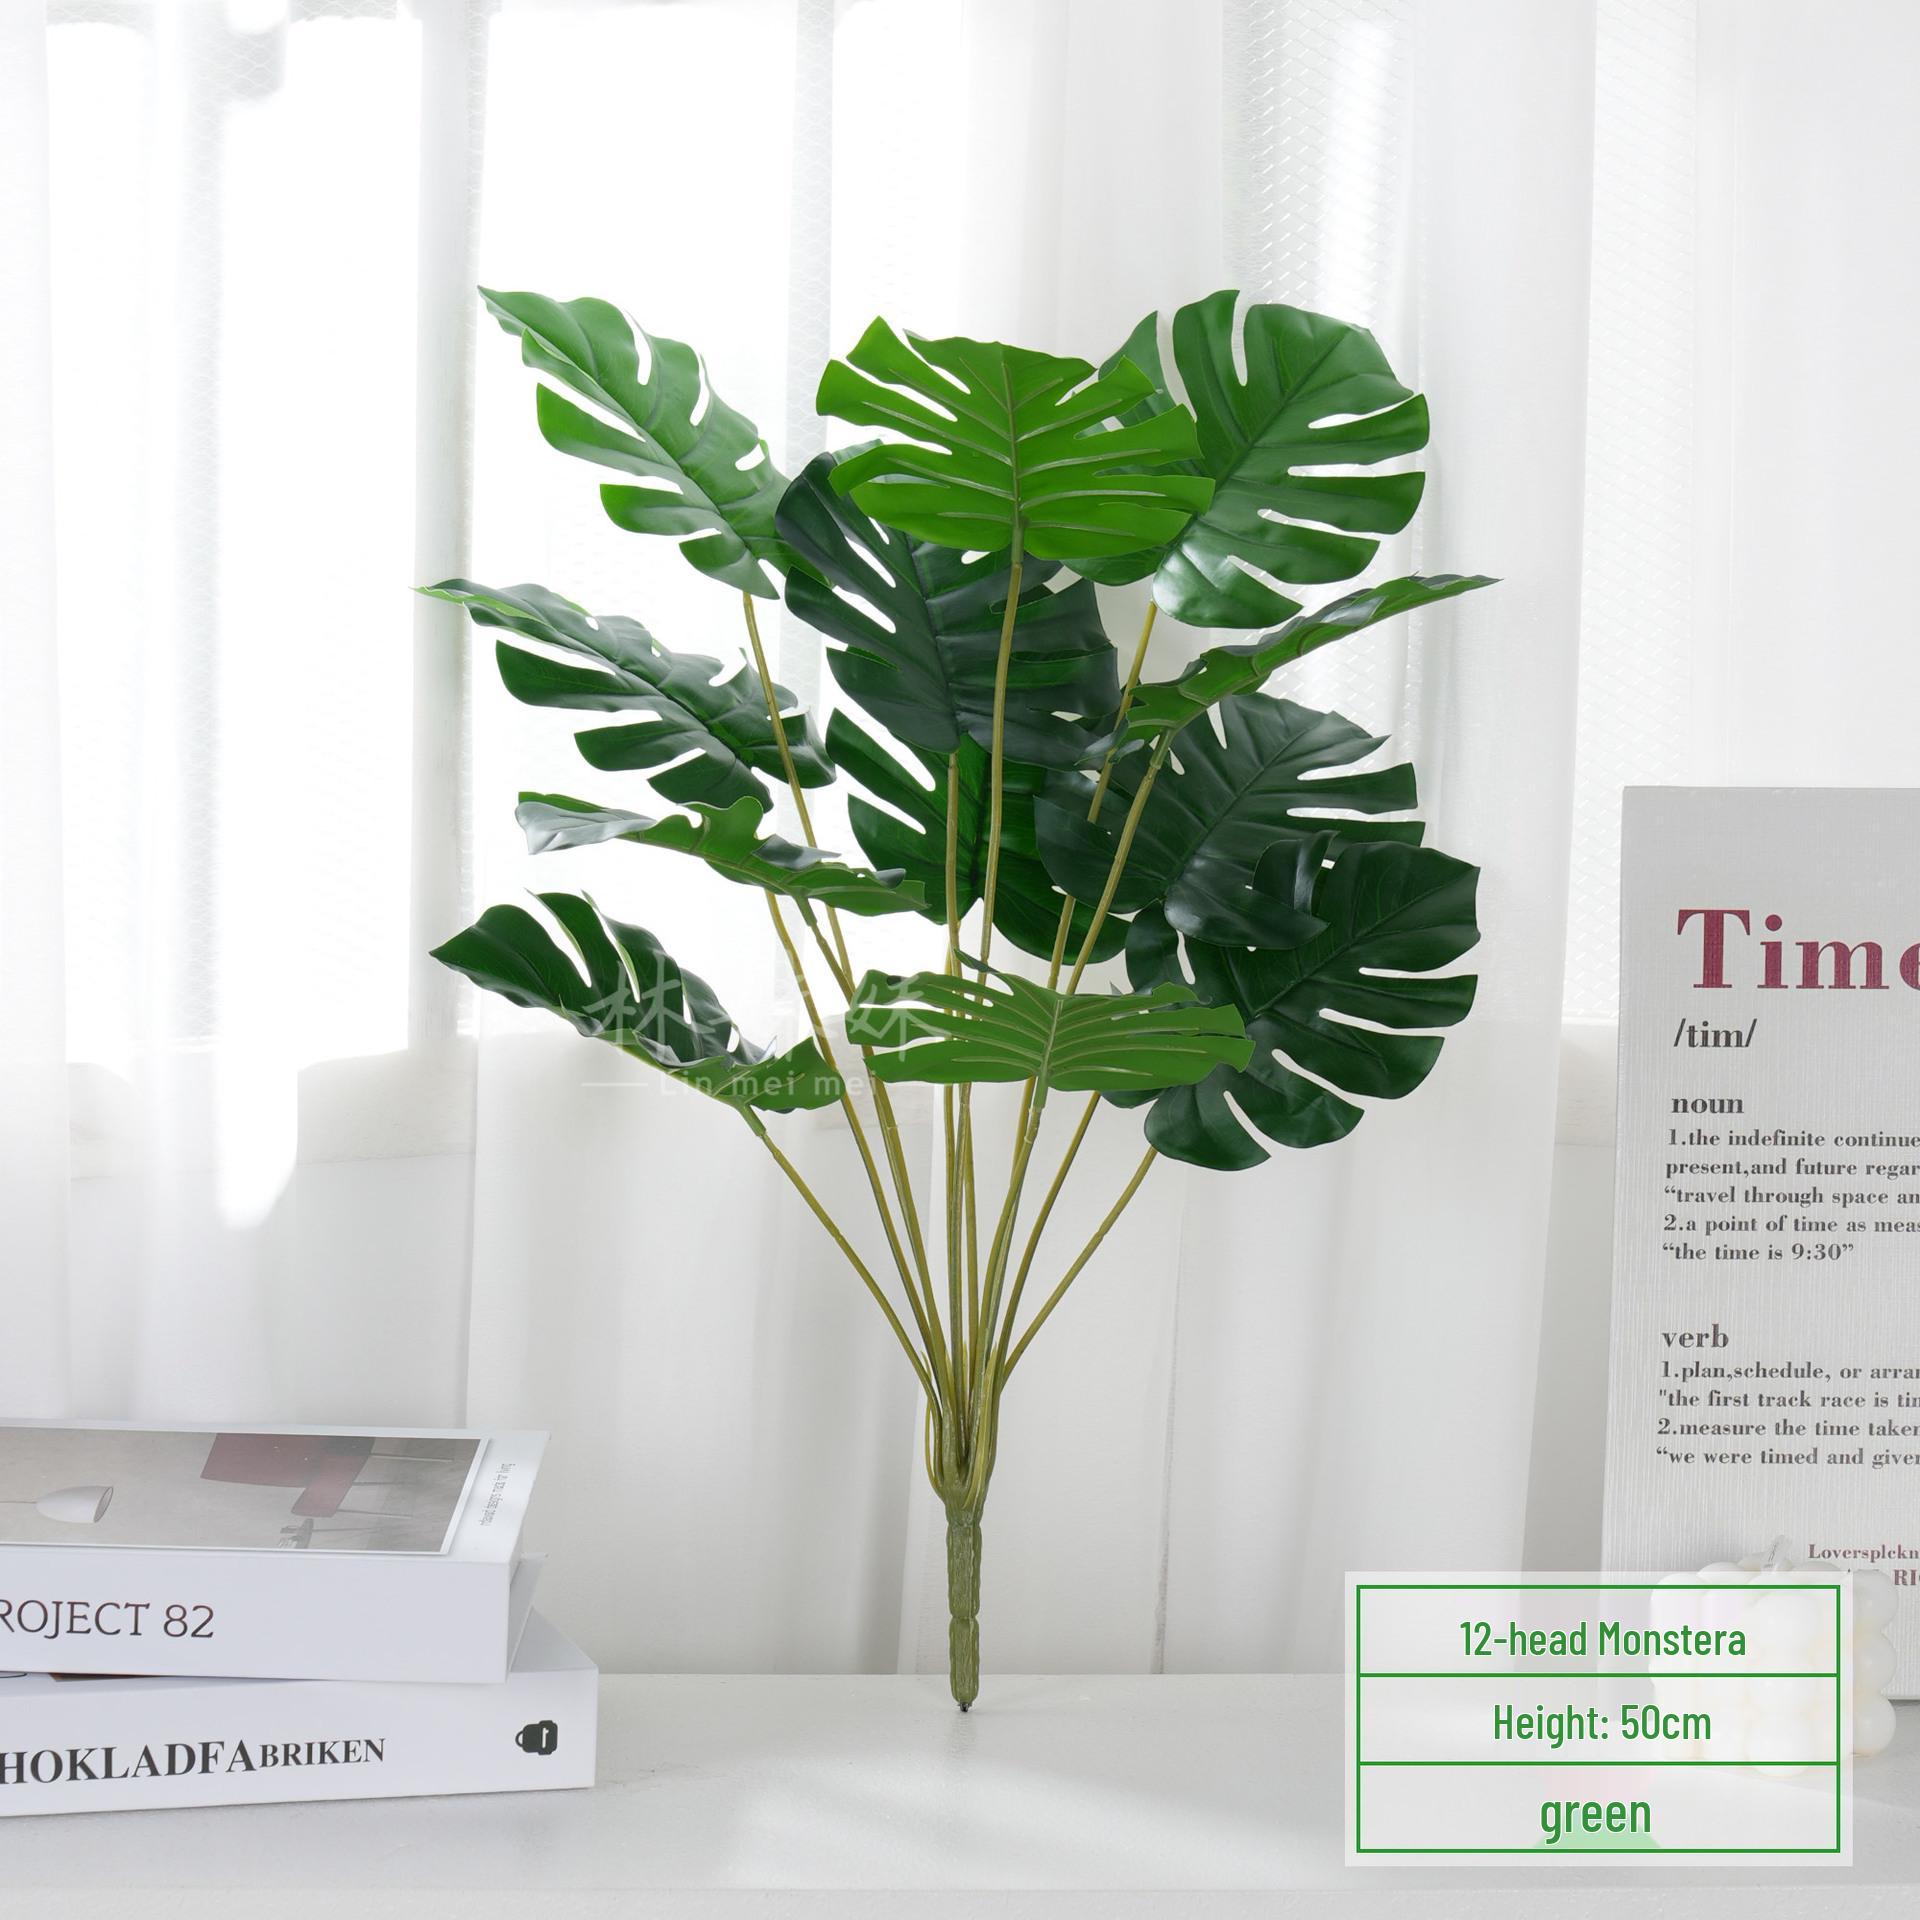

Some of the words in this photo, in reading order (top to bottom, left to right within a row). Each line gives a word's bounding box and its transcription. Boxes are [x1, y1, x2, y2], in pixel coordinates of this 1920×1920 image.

[1674, 1018, 1757, 1048] /tim/
[1671, 1098, 1744, 1114] noun
[1669, 1129, 1720, 1146] 1.the
[1728, 1129, 1825, 1147] indefinite
[1666, 1158, 1787, 1180] present,and
[1796, 1158, 1857, 1175] future
[1744, 1186, 1823, 1208] through
[1832, 1193, 1889, 1208] space
[1664, 1214, 1697, 1232] 2.a
[1706, 1215, 1757, 1236] point
[1766, 1214, 1788, 1231] of
[1794, 1215, 1838, 1232] time
[1847, 1221, 1867, 1232] as
[1716, 1243, 1760, 1260] time
[1768, 1244, 1783, 1260] is
[1662, 1324, 1729, 1348] verb
[1840, 1368, 1862, 1379] or
[1708, 1390, 1749, 1407] first
[1758, 1390, 1811, 1407] track
[1821, 1396, 1866, 1408] race
[1874, 1391, 1889, 1408] is
[1657, 1418, 1766, 1436] 2.measure
[1775, 1419, 1806, 1435] the
[1815, 1420, 1860, 1435] time
[1704, 1453, 1752, 1464] were
[1760, 1447, 1818, 1464] timed
[1827, 1448, 1864, 1464] and
[1894, 1569, 1920, 1586] RI
[163, 1604, 215, 1639] 82
